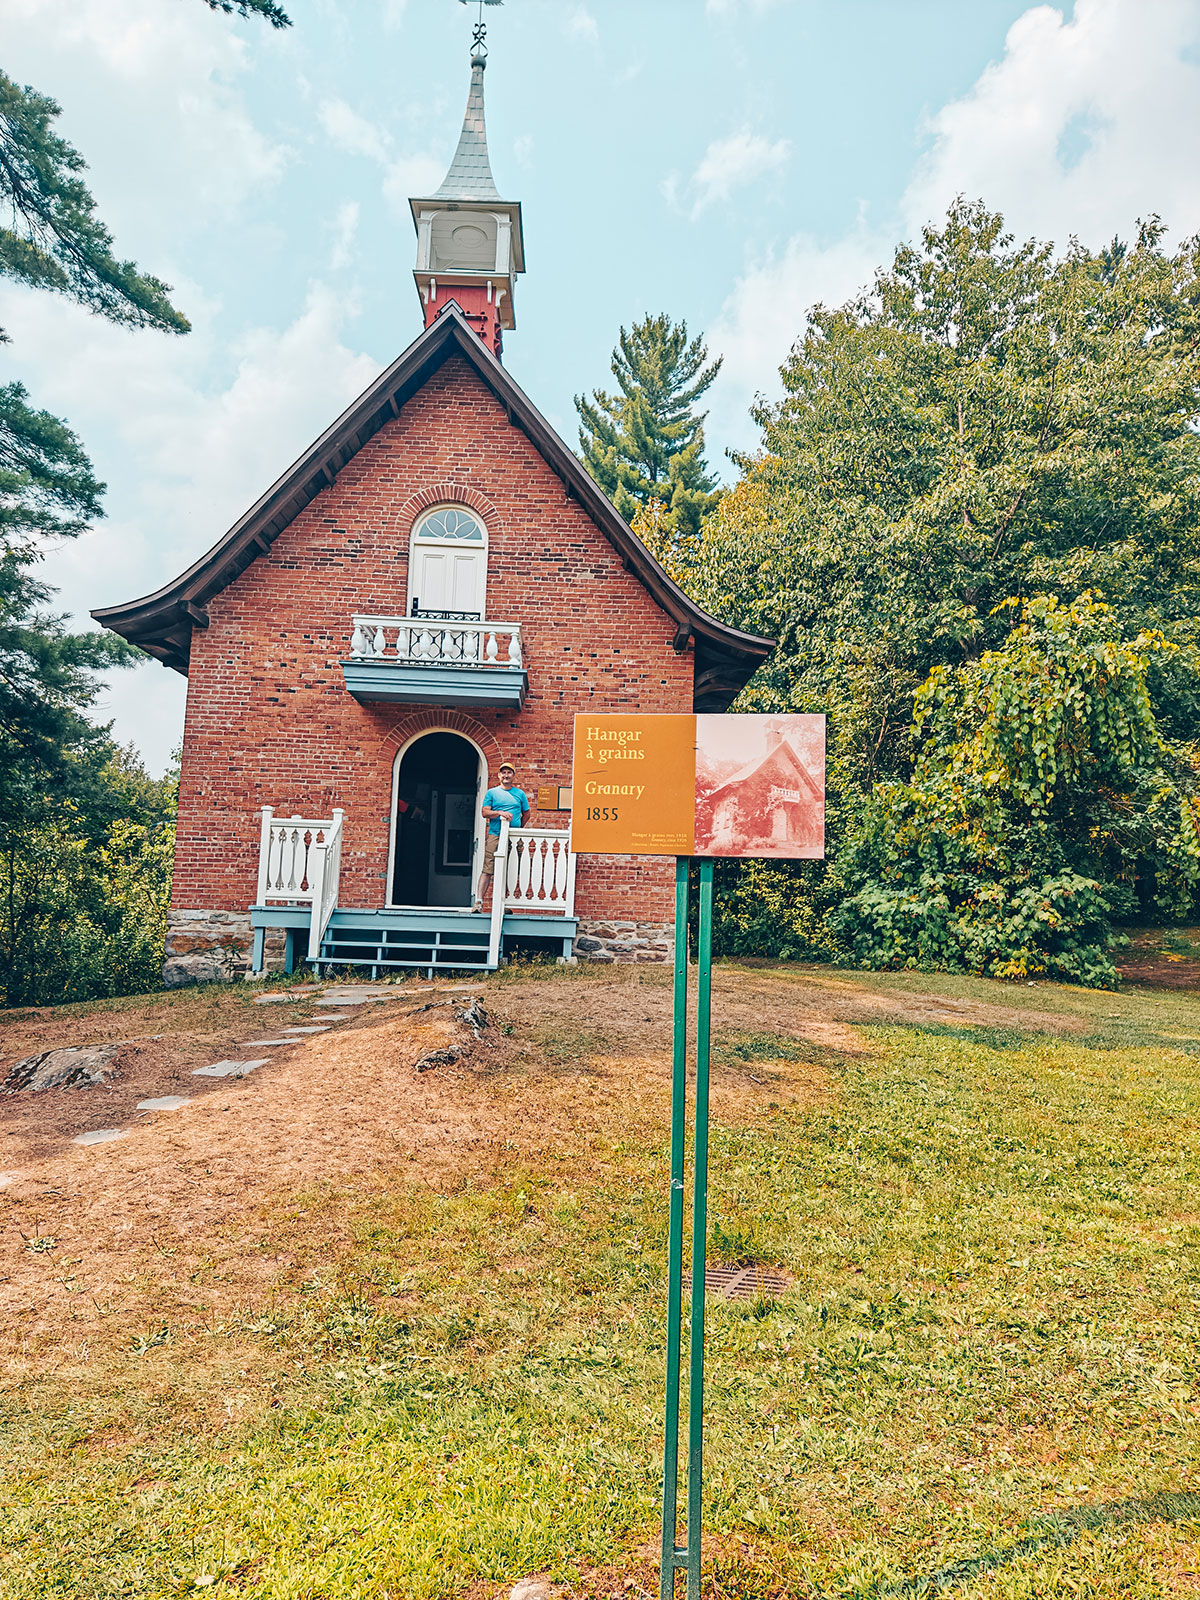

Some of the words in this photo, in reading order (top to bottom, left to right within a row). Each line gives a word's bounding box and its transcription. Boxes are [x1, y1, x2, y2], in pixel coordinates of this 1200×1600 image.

[586, 727, 642, 745] Hangar
[585, 745, 594, 759] à
[598, 746, 645, 764] grains
[585, 781, 645, 800] Granary
[586, 807, 618, 821] 1855
